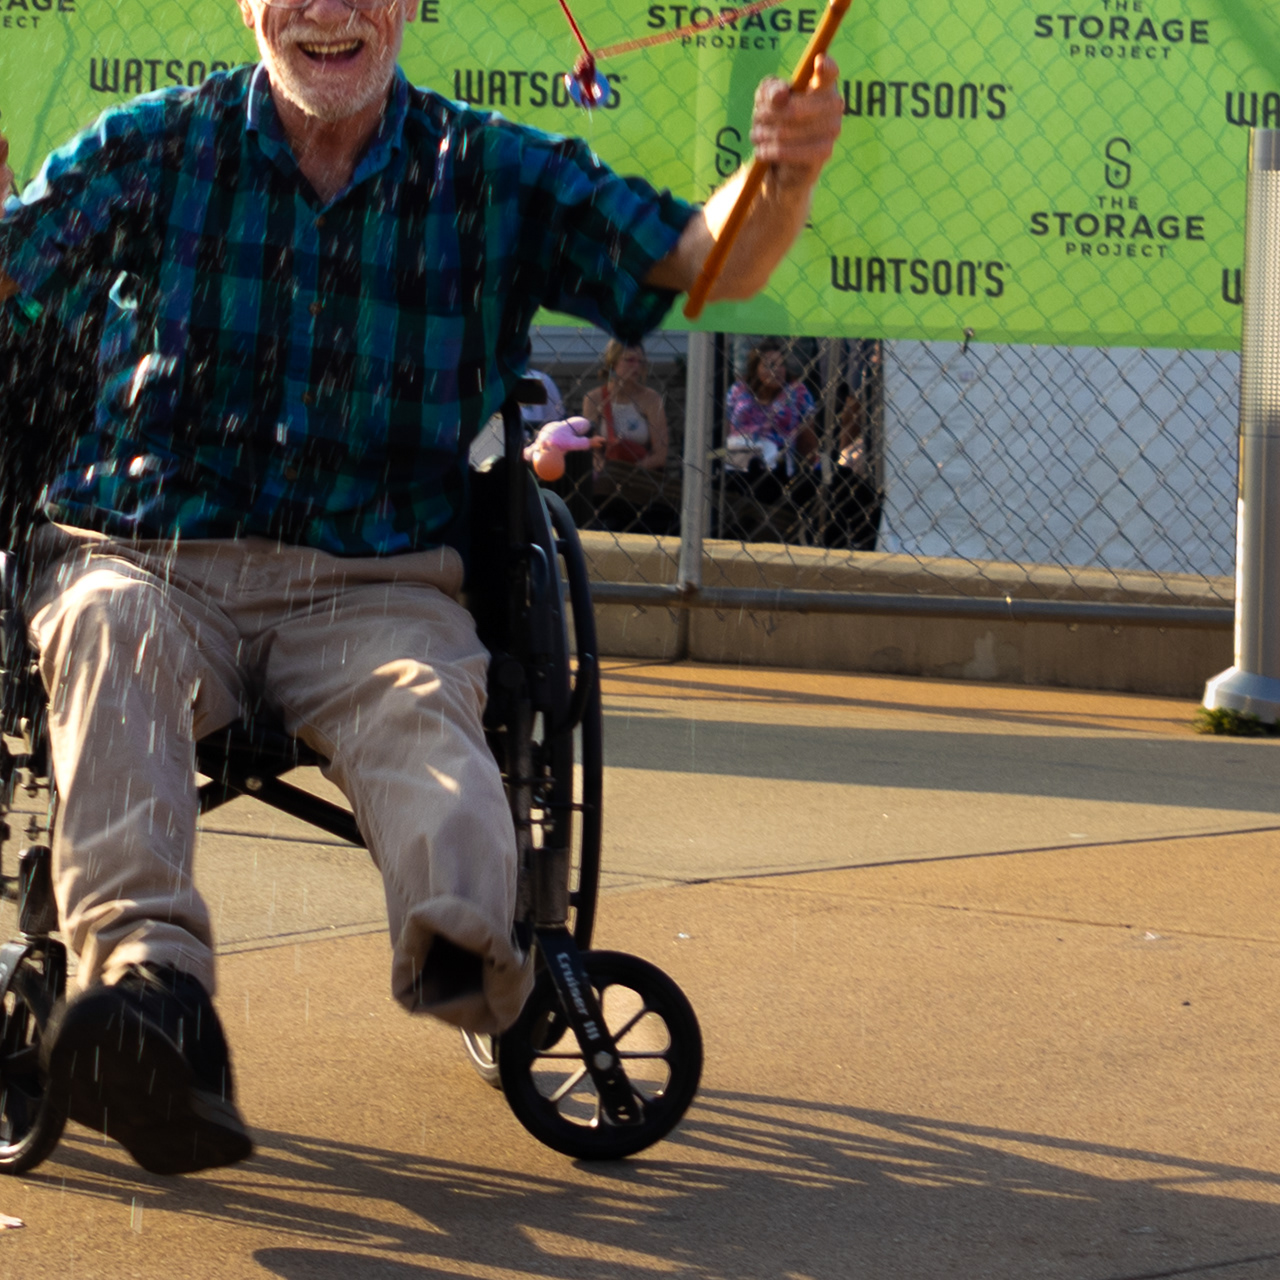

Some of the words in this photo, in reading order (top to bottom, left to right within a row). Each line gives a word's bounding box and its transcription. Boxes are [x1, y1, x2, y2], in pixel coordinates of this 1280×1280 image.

[1103, 0, 1142, 12] THE
[647, 5, 816, 33] STORAGE
[1034, 15, 1210, 44] STORAGE
[681, 36, 779, 50] PROJECT
[1070, 45, 1172, 60] PROJECT
[843, 80, 1006, 120] WATSON'S
[1098, 196, 1137, 210] THE
[1030, 212, 1205, 240] STORAGE
[1066, 242, 1167, 258] PROJECT
[831, 256, 1004, 297] WATSON'S
